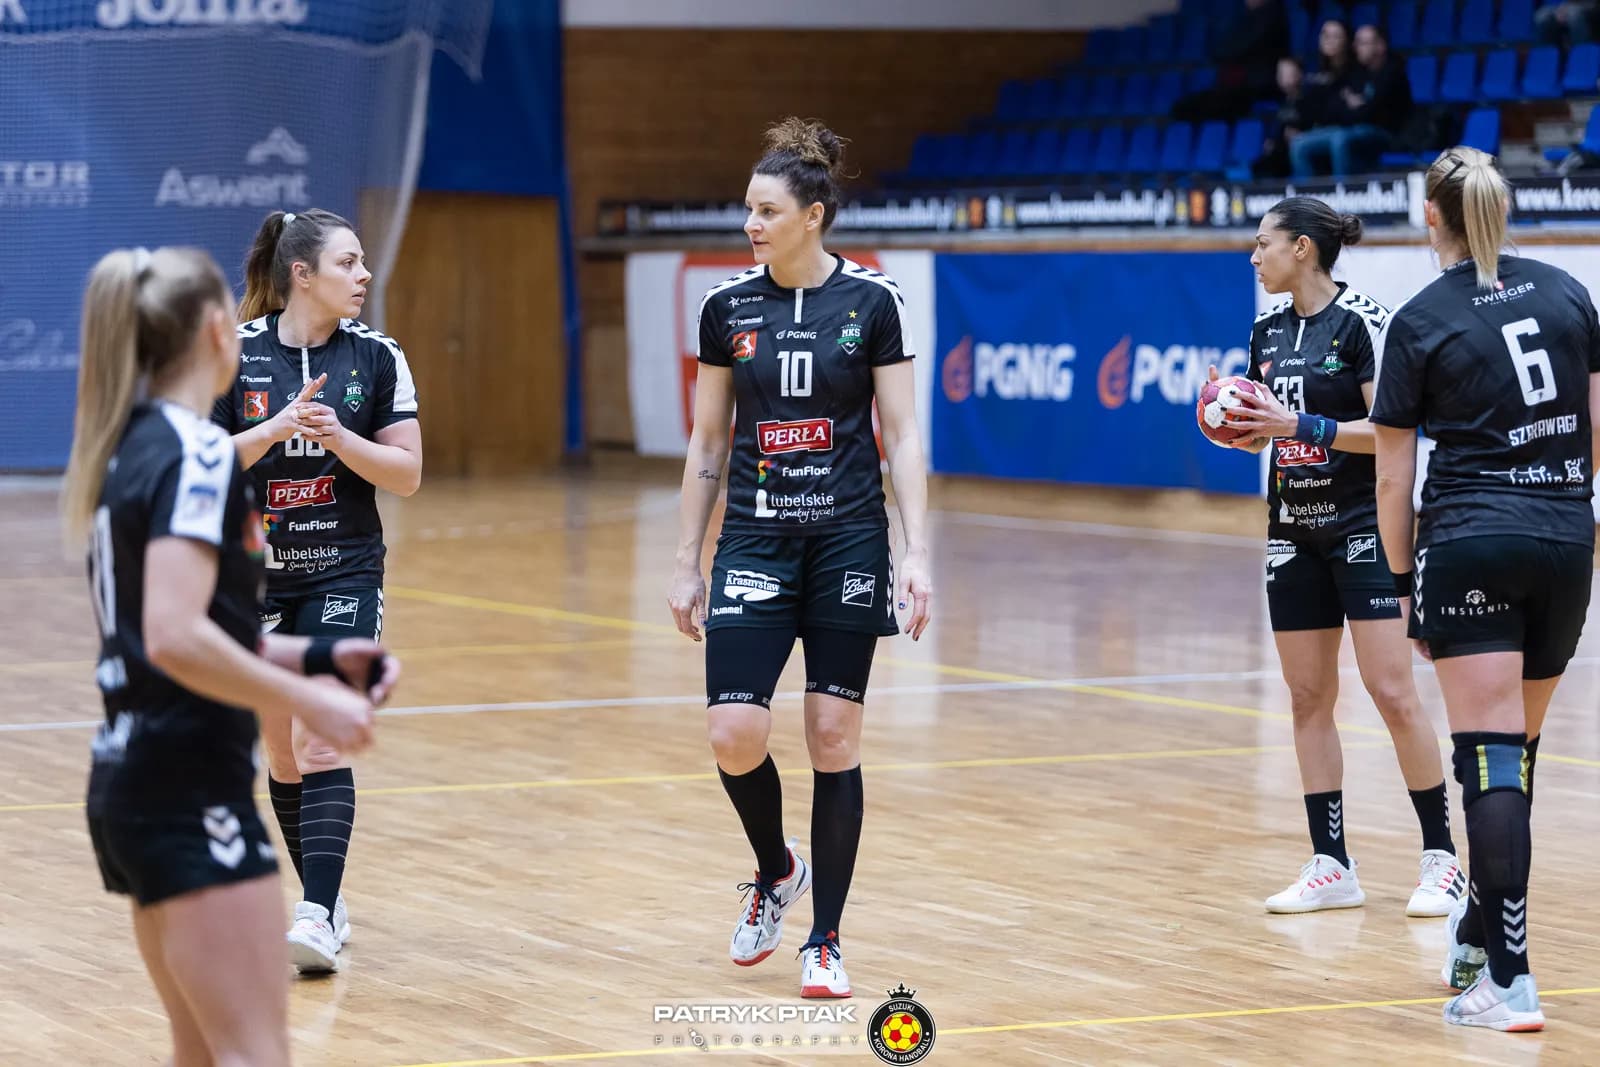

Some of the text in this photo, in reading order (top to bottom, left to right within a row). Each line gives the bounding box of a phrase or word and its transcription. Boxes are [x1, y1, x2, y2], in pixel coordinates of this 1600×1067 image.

[1471, 282, 1536, 306] ZWIEGER
[841, 328, 861, 338] MKS
[1501, 317, 1558, 406] 6
[776, 351, 813, 397] 10
[346, 386, 362, 396] MKS
[1273, 375, 1306, 415] 33
[763, 425, 826, 447] PERŁA
[782, 466, 832, 478] FunFloor
[1288, 478, 1333, 489] FunFloor
[288, 520, 339, 531] FunFloor
[845, 578, 875, 594] Ball
[325, 600, 357, 615] Ball
[1369, 597, 1399, 606] SELECT
[711, 605, 743, 616] hummel
[730, 692, 754, 702] cep
[839, 687, 860, 699] cep
